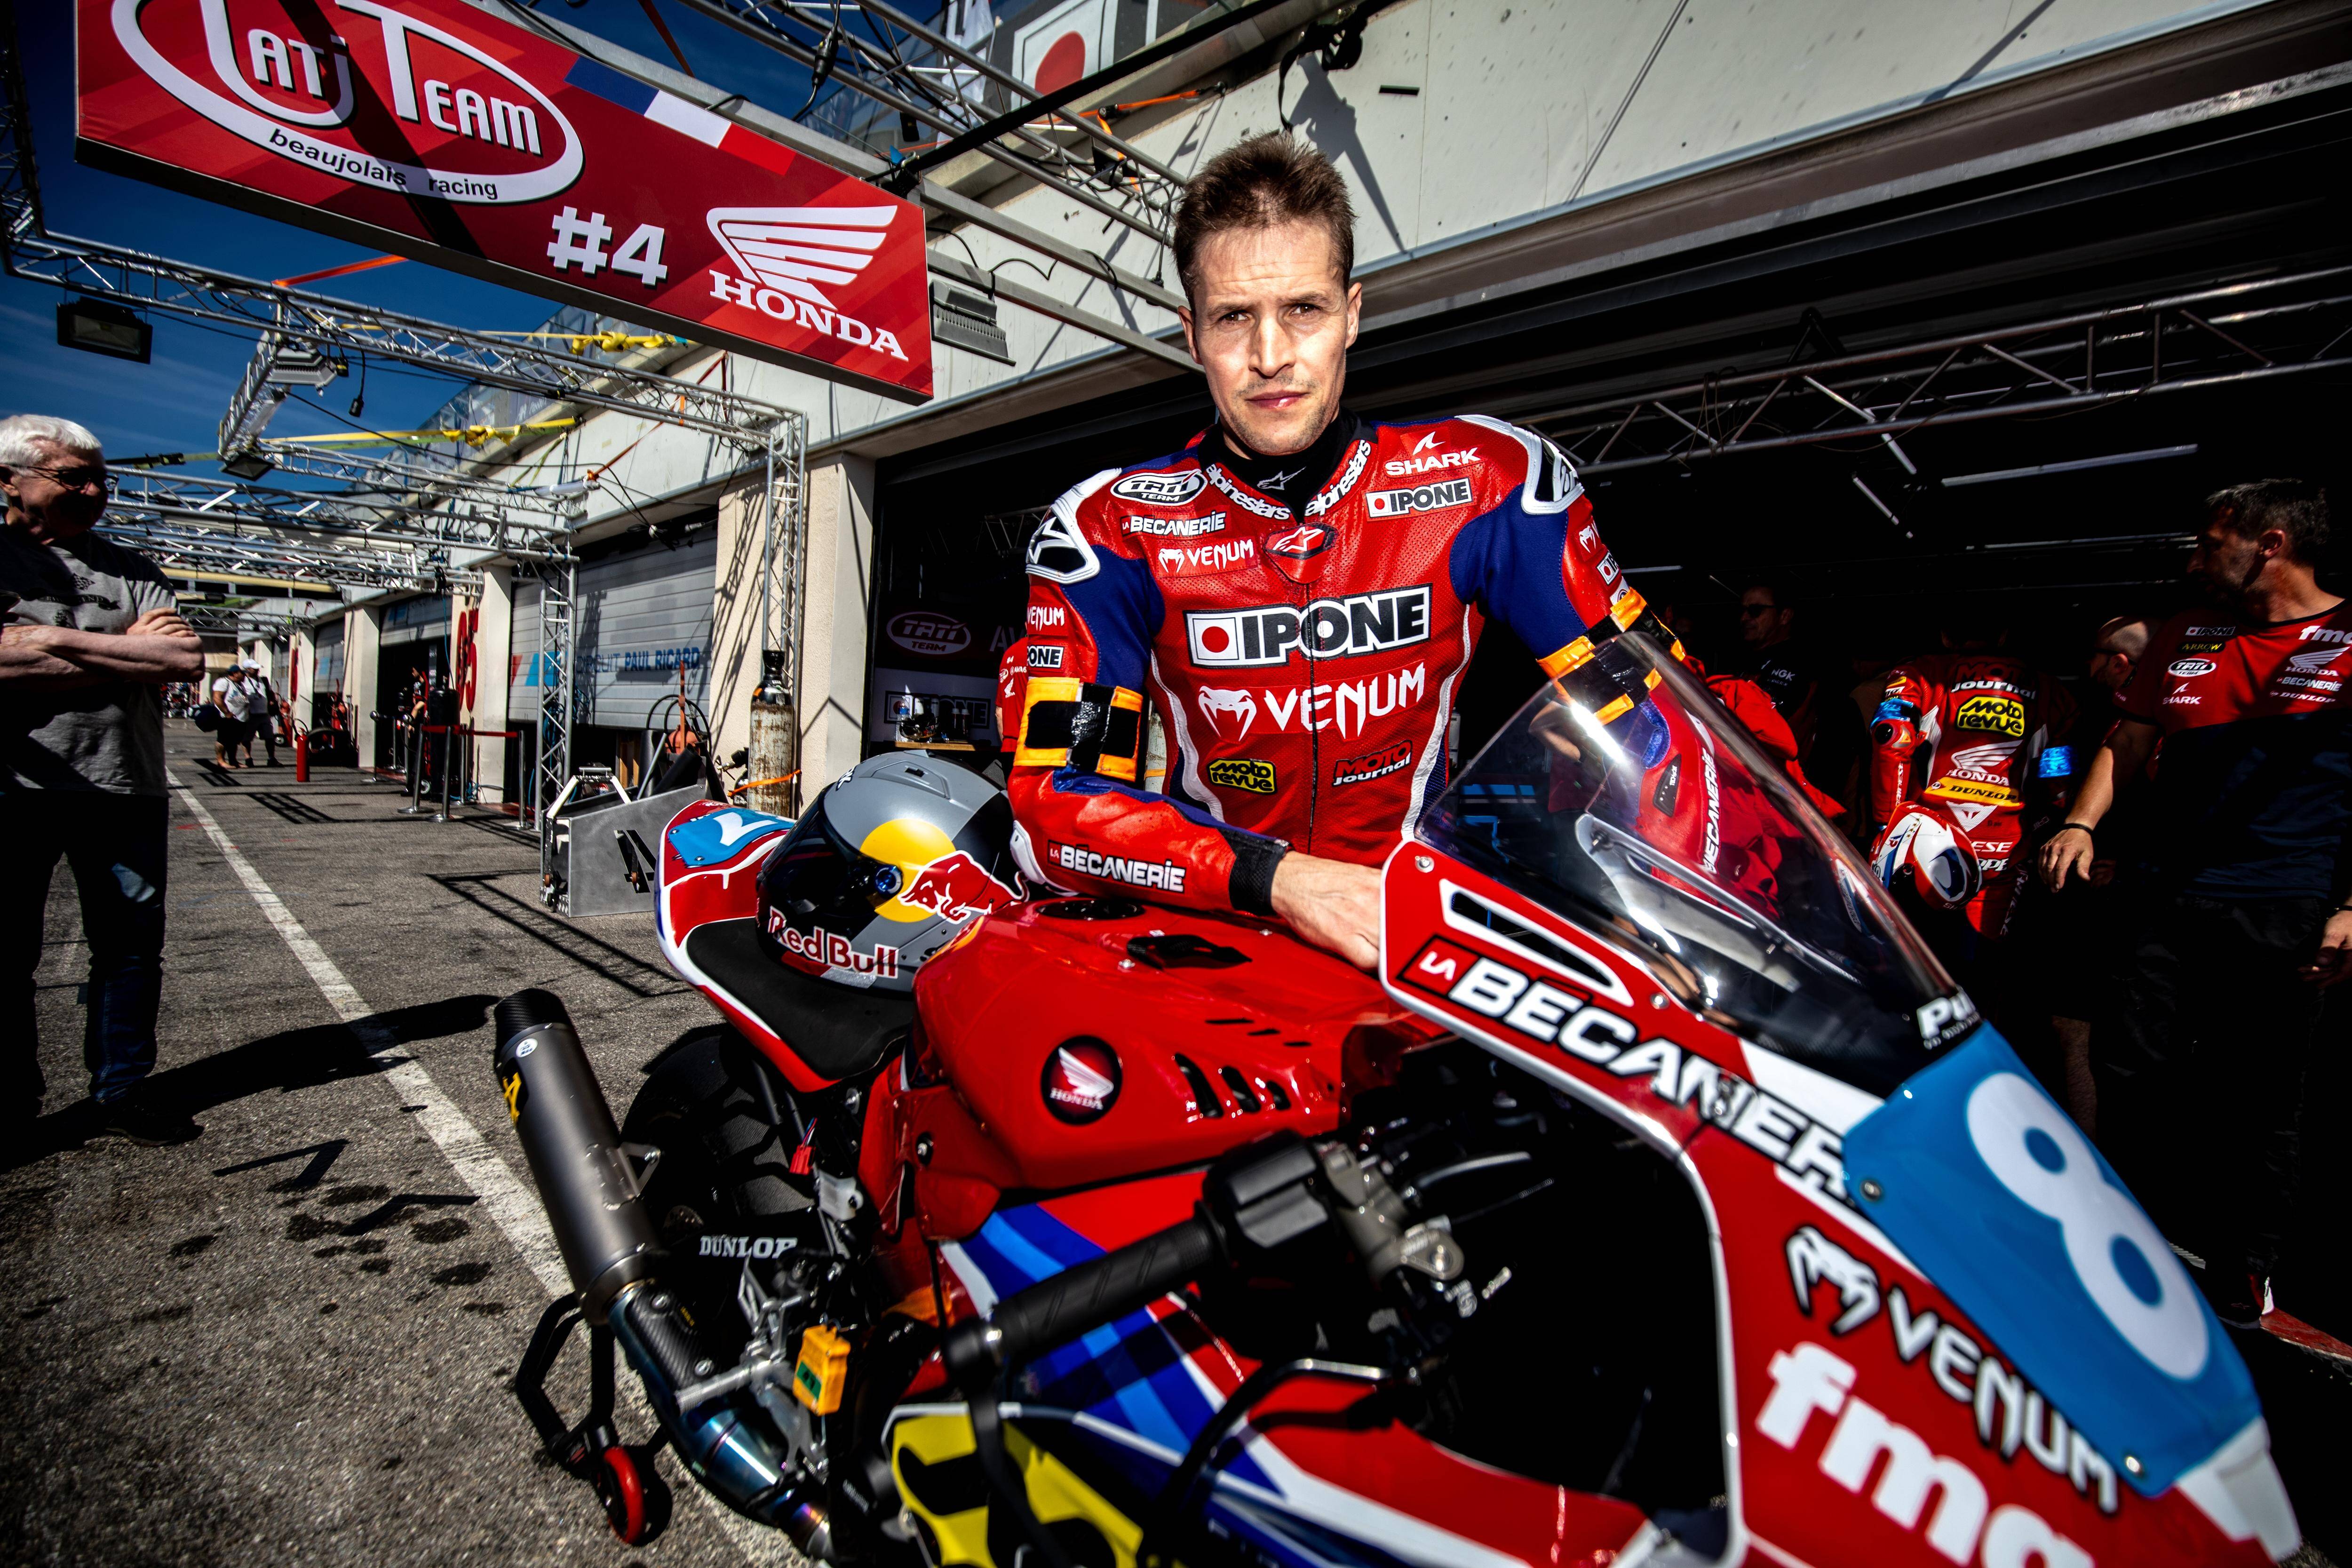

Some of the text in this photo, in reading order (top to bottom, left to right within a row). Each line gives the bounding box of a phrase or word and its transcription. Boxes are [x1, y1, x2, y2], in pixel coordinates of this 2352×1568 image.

[270, 128, 499, 201] beaujolais racing
[547, 206, 668, 285] #4
[709, 269, 908, 362] HONDA
[1386, 447, 1481, 476] SHARK
[1206, 463, 1291, 520] alpinestars
[1304, 439, 1371, 517] alpinestars
[1141, 493, 1180, 501] TEAM
[1390, 478, 1471, 512] IPONE
[1187, 539, 1255, 570] VENUM
[1241, 593, 1424, 659] IPONE
[2196, 627, 2235, 636] IPONE
[576, 646, 700, 673] CIRCUIT PAUL RICARD
[912, 641, 946, 652] TEAM
[1027, 646, 1062, 666] ONE
[1771, 669, 1796, 682] NGK
[2284, 666, 2339, 677] HONDA
[1263, 662, 1425, 740] VENUM
[2162, 696, 2202, 705] SHARK
[2279, 692, 2336, 703] DUNLOP
[1335, 741, 1411, 777] MOTO
[1946, 768, 2010, 786] HONDA
[1949, 785, 2018, 801] DUNLOP
[1418, 951, 1457, 981] LA
[1050, 1087, 1104, 1110] HONDA
[1966, 1071, 2209, 1381] 8
[1887, 1287, 2118, 1513] VENUM
